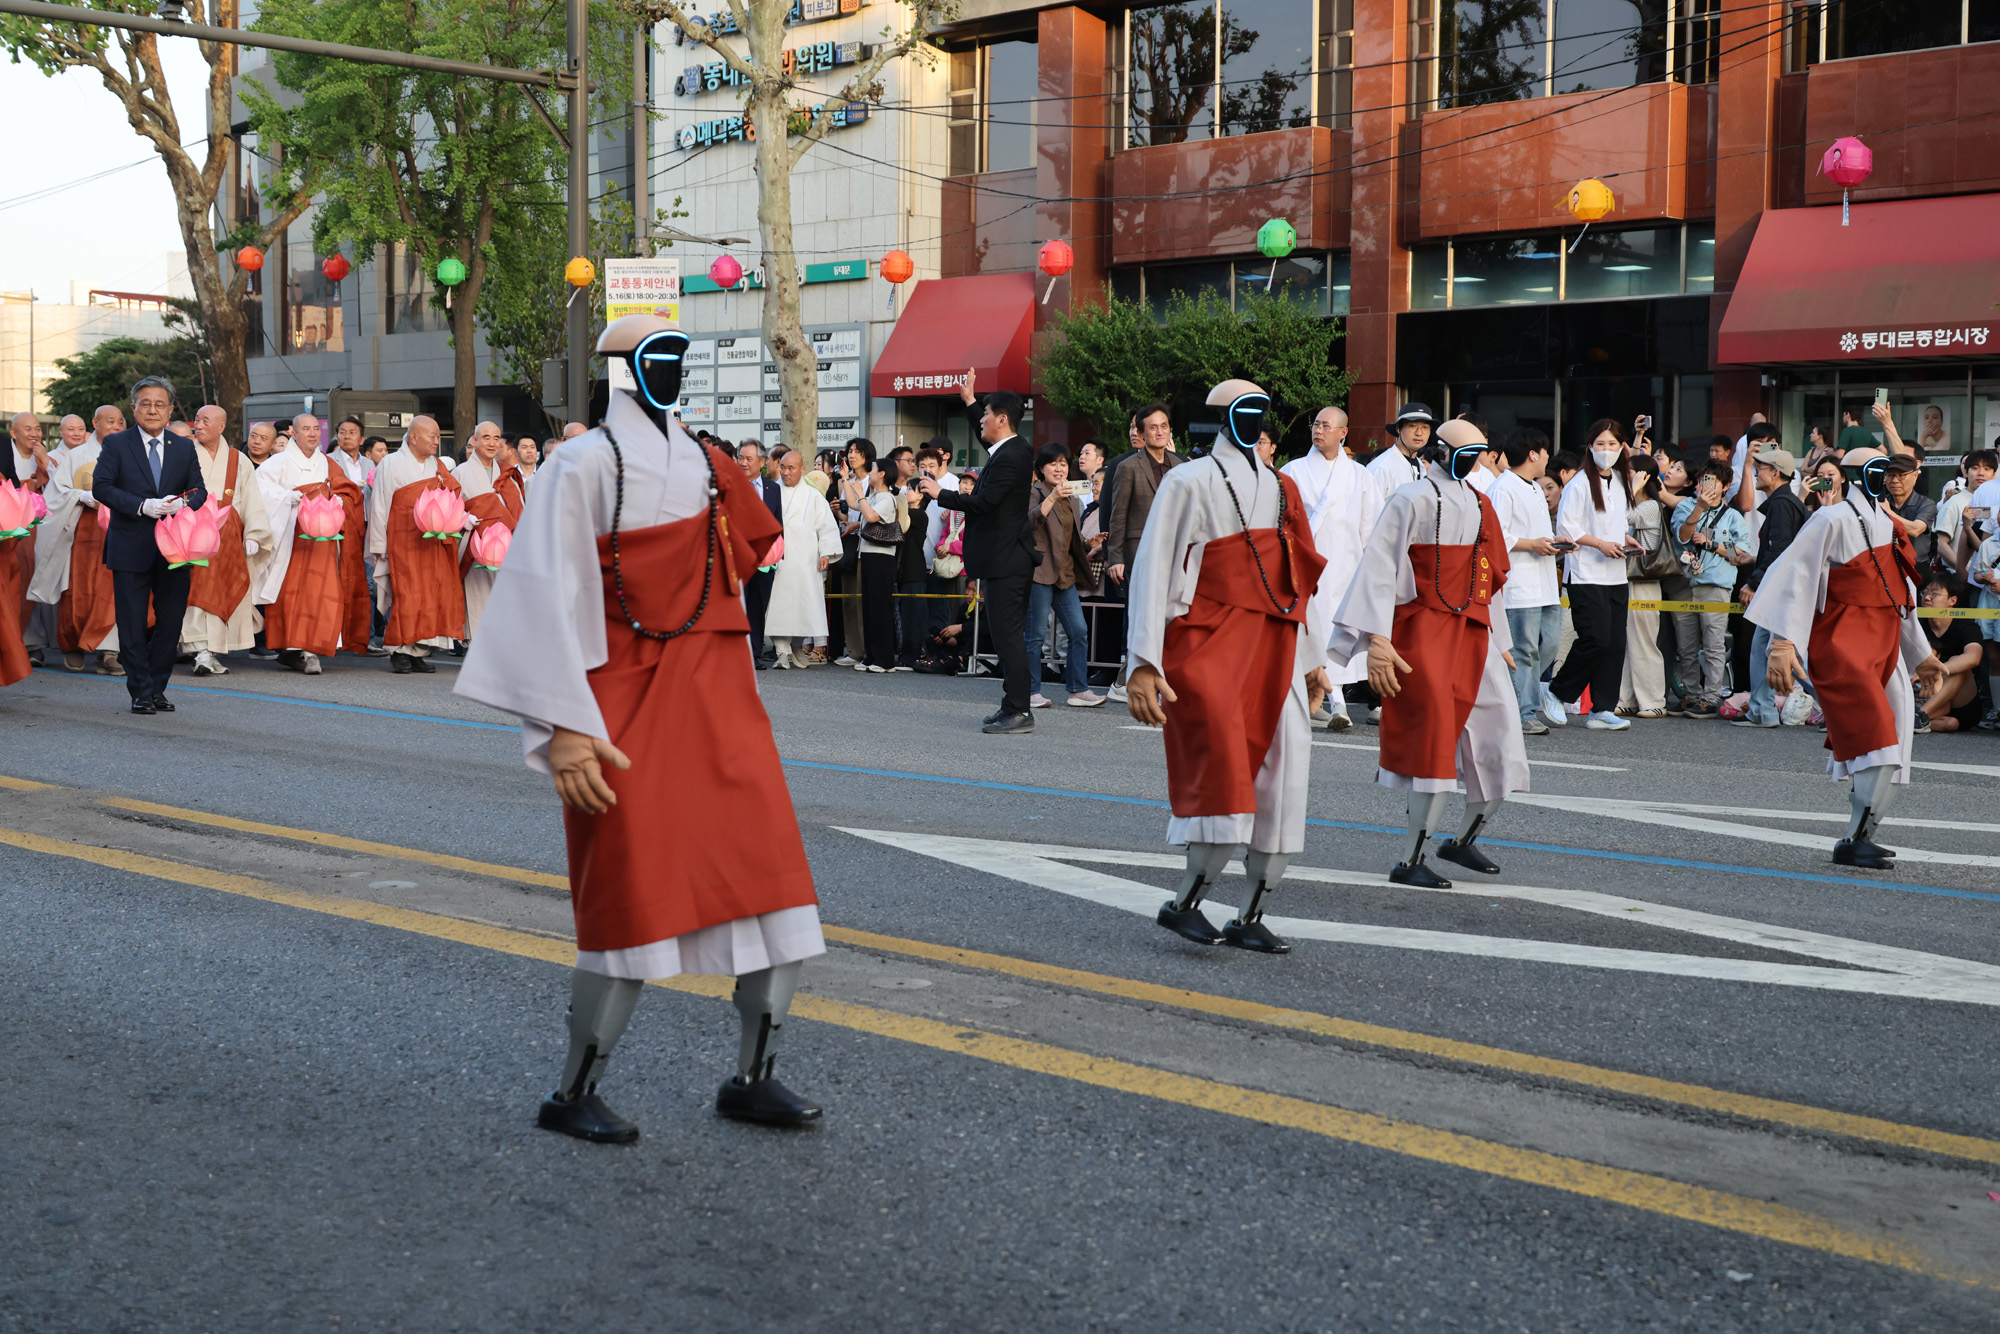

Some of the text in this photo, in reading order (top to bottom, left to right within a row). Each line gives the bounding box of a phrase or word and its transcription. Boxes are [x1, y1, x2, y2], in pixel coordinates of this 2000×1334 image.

[806, 0, 835, 16] 피부과
[833, 265, 850, 276] 동대문
[609, 278, 676, 289] 교통통제안내
[1861, 327, 1990, 350] 동대문종합시장
